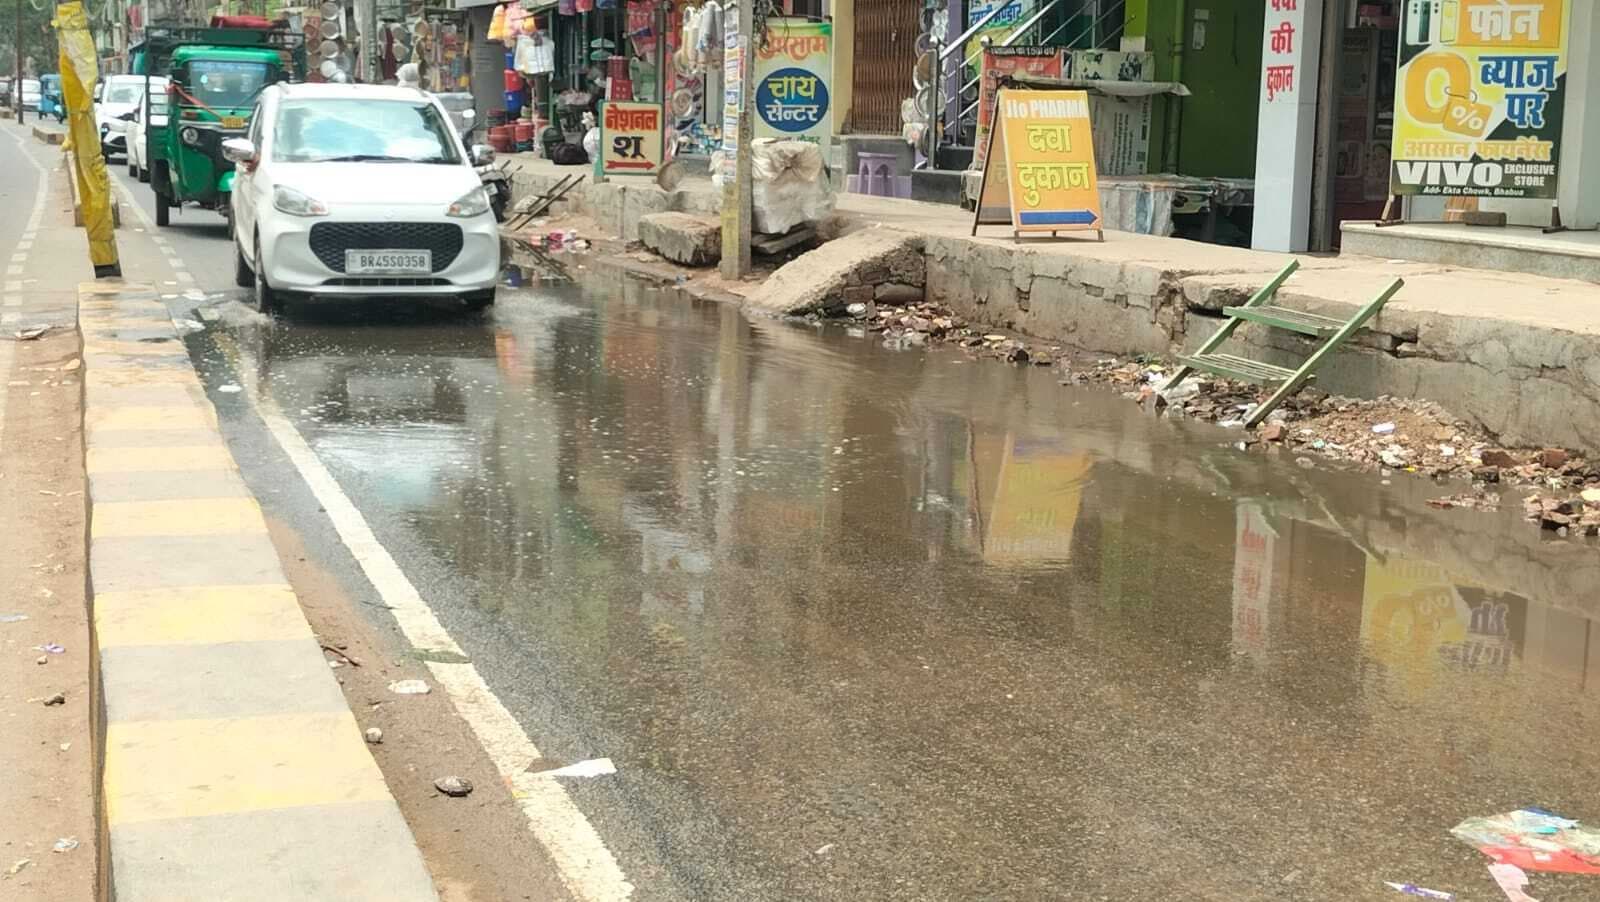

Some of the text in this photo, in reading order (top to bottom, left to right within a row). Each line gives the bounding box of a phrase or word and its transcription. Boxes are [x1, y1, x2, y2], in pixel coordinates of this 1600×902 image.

[1467, 1, 1544, 41] फोन
[1270, 21, 1295, 54] की
[1266, 65, 1294, 102] दुकान
[1478, 56, 1560, 90] ब्याज
[767, 76, 817, 100] चाय
[606, 104, 658, 131] नेशनल
[765, 99, 819, 121] सेन्टर
[1029, 99, 1089, 119] PHARMA
[1504, 93, 1547, 127] पर
[1026, 124, 1072, 153] दवा
[1404, 138, 1469, 160] आसान
[1016, 162, 1091, 208] दुकान
[1396, 161, 1555, 187] VIVO EXCLUSIVE
[1514, 176, 1545, 187] STORE
[360, 255, 426, 268] BR45S0358
